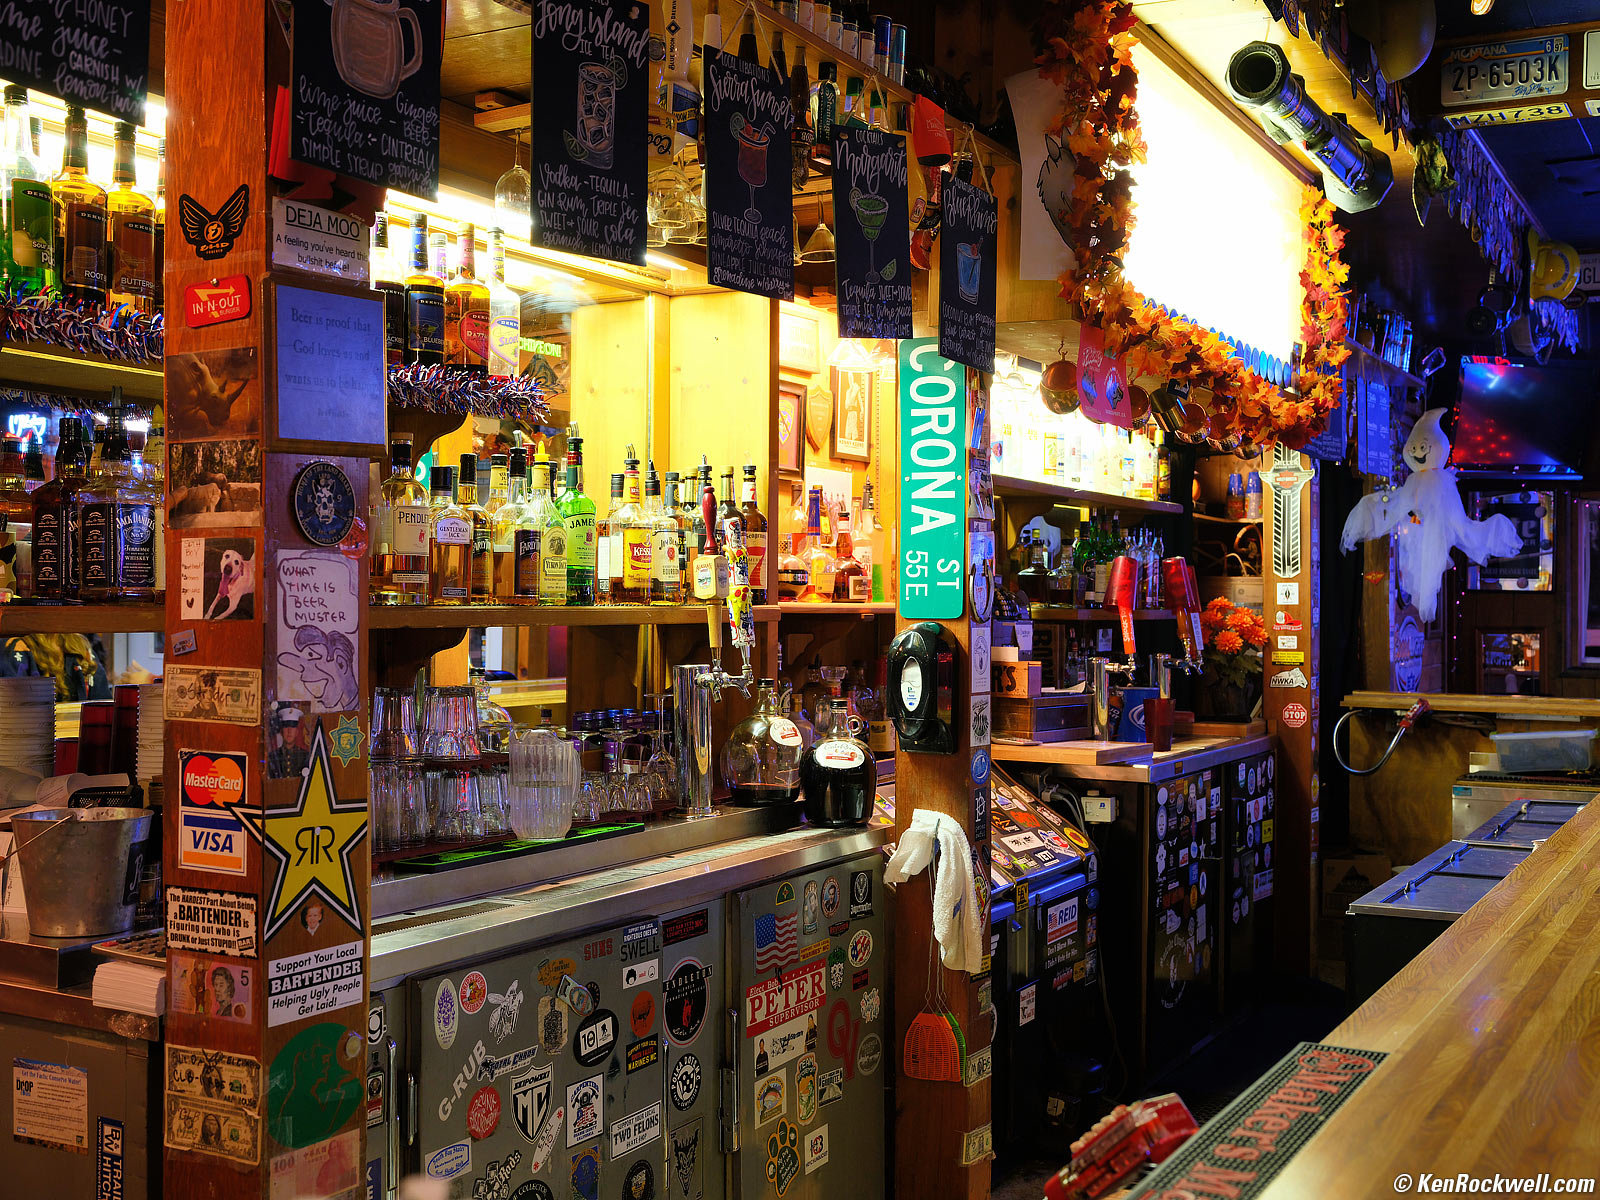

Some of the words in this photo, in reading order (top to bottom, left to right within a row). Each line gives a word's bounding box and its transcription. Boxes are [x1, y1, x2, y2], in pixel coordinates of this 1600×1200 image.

[69, 50, 119, 86] GARNISH
[855, 129, 885, 146] COCKTAILS
[301, 137, 341, 169] SIMPLE
[347, 153, 383, 180] SYRUP
[537, 190, 555, 209] GIN
[285, 205, 323, 230] DEJA
[327, 215, 360, 238] MOO
[275, 233, 282, 243] A
[284, 234, 309, 251] feeling
[310, 241, 334, 255] you've
[335, 246, 356, 260] heard
[297, 252, 323, 268] bullshit
[192, 294, 242, 316] IN-N-OUT
[291, 307, 313, 325] Beer
[315, 316, 323, 325] is
[325, 316, 350, 331] proof
[293, 339, 314, 355] God
[909, 344, 957, 536] CORONA
[116, 513, 131, 529] JACK
[439, 525, 470, 536] GENTLEMAN
[448, 531, 461, 539] JACK
[282, 566, 317, 577] WHAT
[936, 558, 960, 590] ST
[286, 582, 319, 593] TIME
[323, 582, 336, 594] IS
[288, 595, 328, 609] BEER
[294, 611, 346, 624] MUSTER
[1284, 710, 1306, 720] STOP
[185, 771, 241, 792] MasterCard
[191, 829, 234, 854] VISA
[170, 893, 180, 902] The
[181, 894, 205, 906] HARDEST
[206, 897, 219, 907] Part
[219, 899, 236, 909] About
[237, 900, 255, 912] Being
[174, 912, 178, 920] a
[179, 904, 241, 928] BARTENDER
[243, 918, 249, 929] is
[1057, 904, 1078, 926] REID
[170, 920, 200, 934] Figuring
[202, 924, 214, 934] out
[216, 926, 231, 937] who
[233, 929, 240, 938] is
[170, 932, 190, 943] DRUNK
[191, 935, 197, 943] or
[275, 956, 311, 974] Support
[314, 951, 333, 964] Your
[336, 944, 357, 959] Local
[584, 938, 613, 961] SUNS
[620, 936, 660, 962] SWELL
[240, 970, 249, 987] 5
[270, 960, 361, 995] BARTENDER
[750, 983, 765, 996] Elect
[767, 980, 778, 989] Bob
[272, 992, 307, 1010] Helping
[310, 985, 330, 1001] Ugly
[332, 978, 361, 992] People
[749, 970, 825, 1024] PETER
[297, 1005, 314, 1016] Get
[316, 997, 337, 1011] Laid!
[769, 997, 820, 1027] SUPERVISOR
[613, 1126, 632, 1146] TWO
[633, 1113, 659, 1137] FELONS
